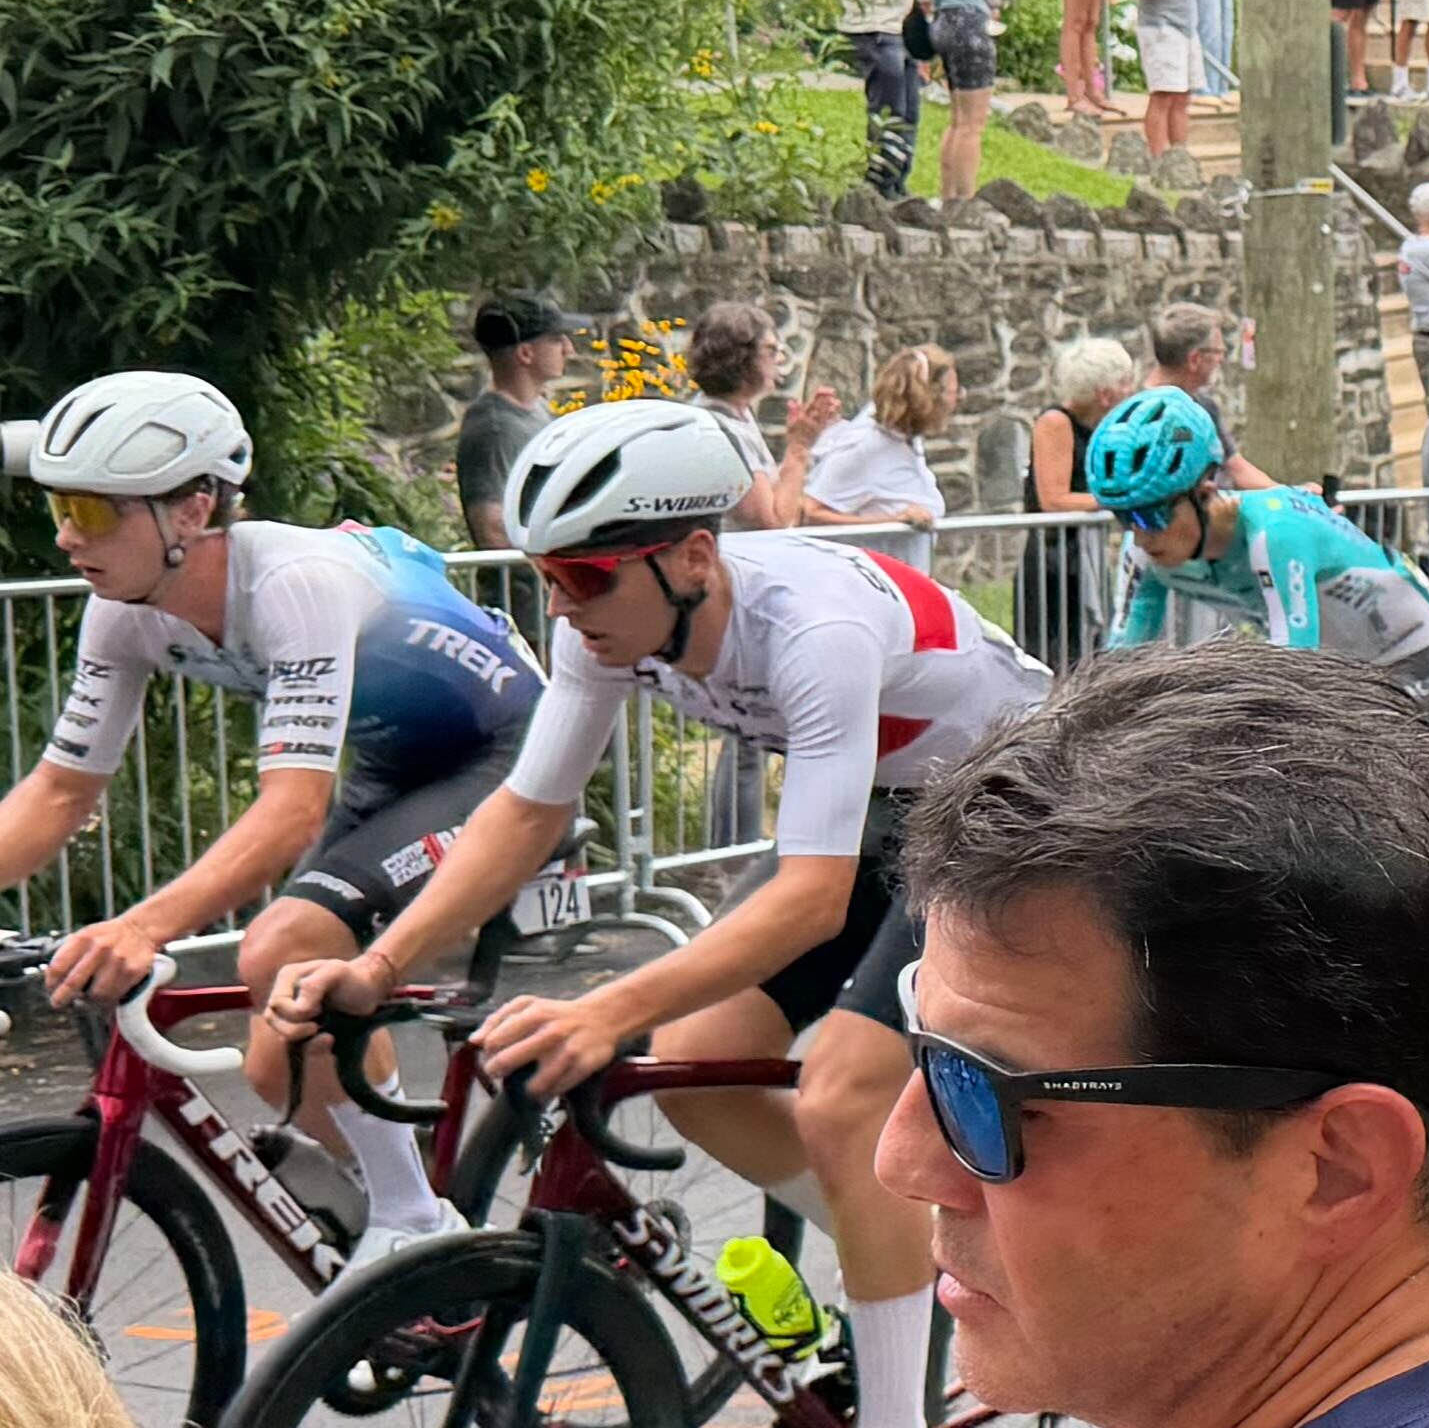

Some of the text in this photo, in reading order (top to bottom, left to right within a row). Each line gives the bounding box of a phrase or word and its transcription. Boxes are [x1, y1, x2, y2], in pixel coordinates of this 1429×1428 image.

[623, 492, 730, 514] S-WORKS
[406, 618, 518, 694] TREK
[537, 881, 580, 929] 124
[178, 1077, 347, 1280] TREK
[613, 1208, 796, 1403] S-WORKS
